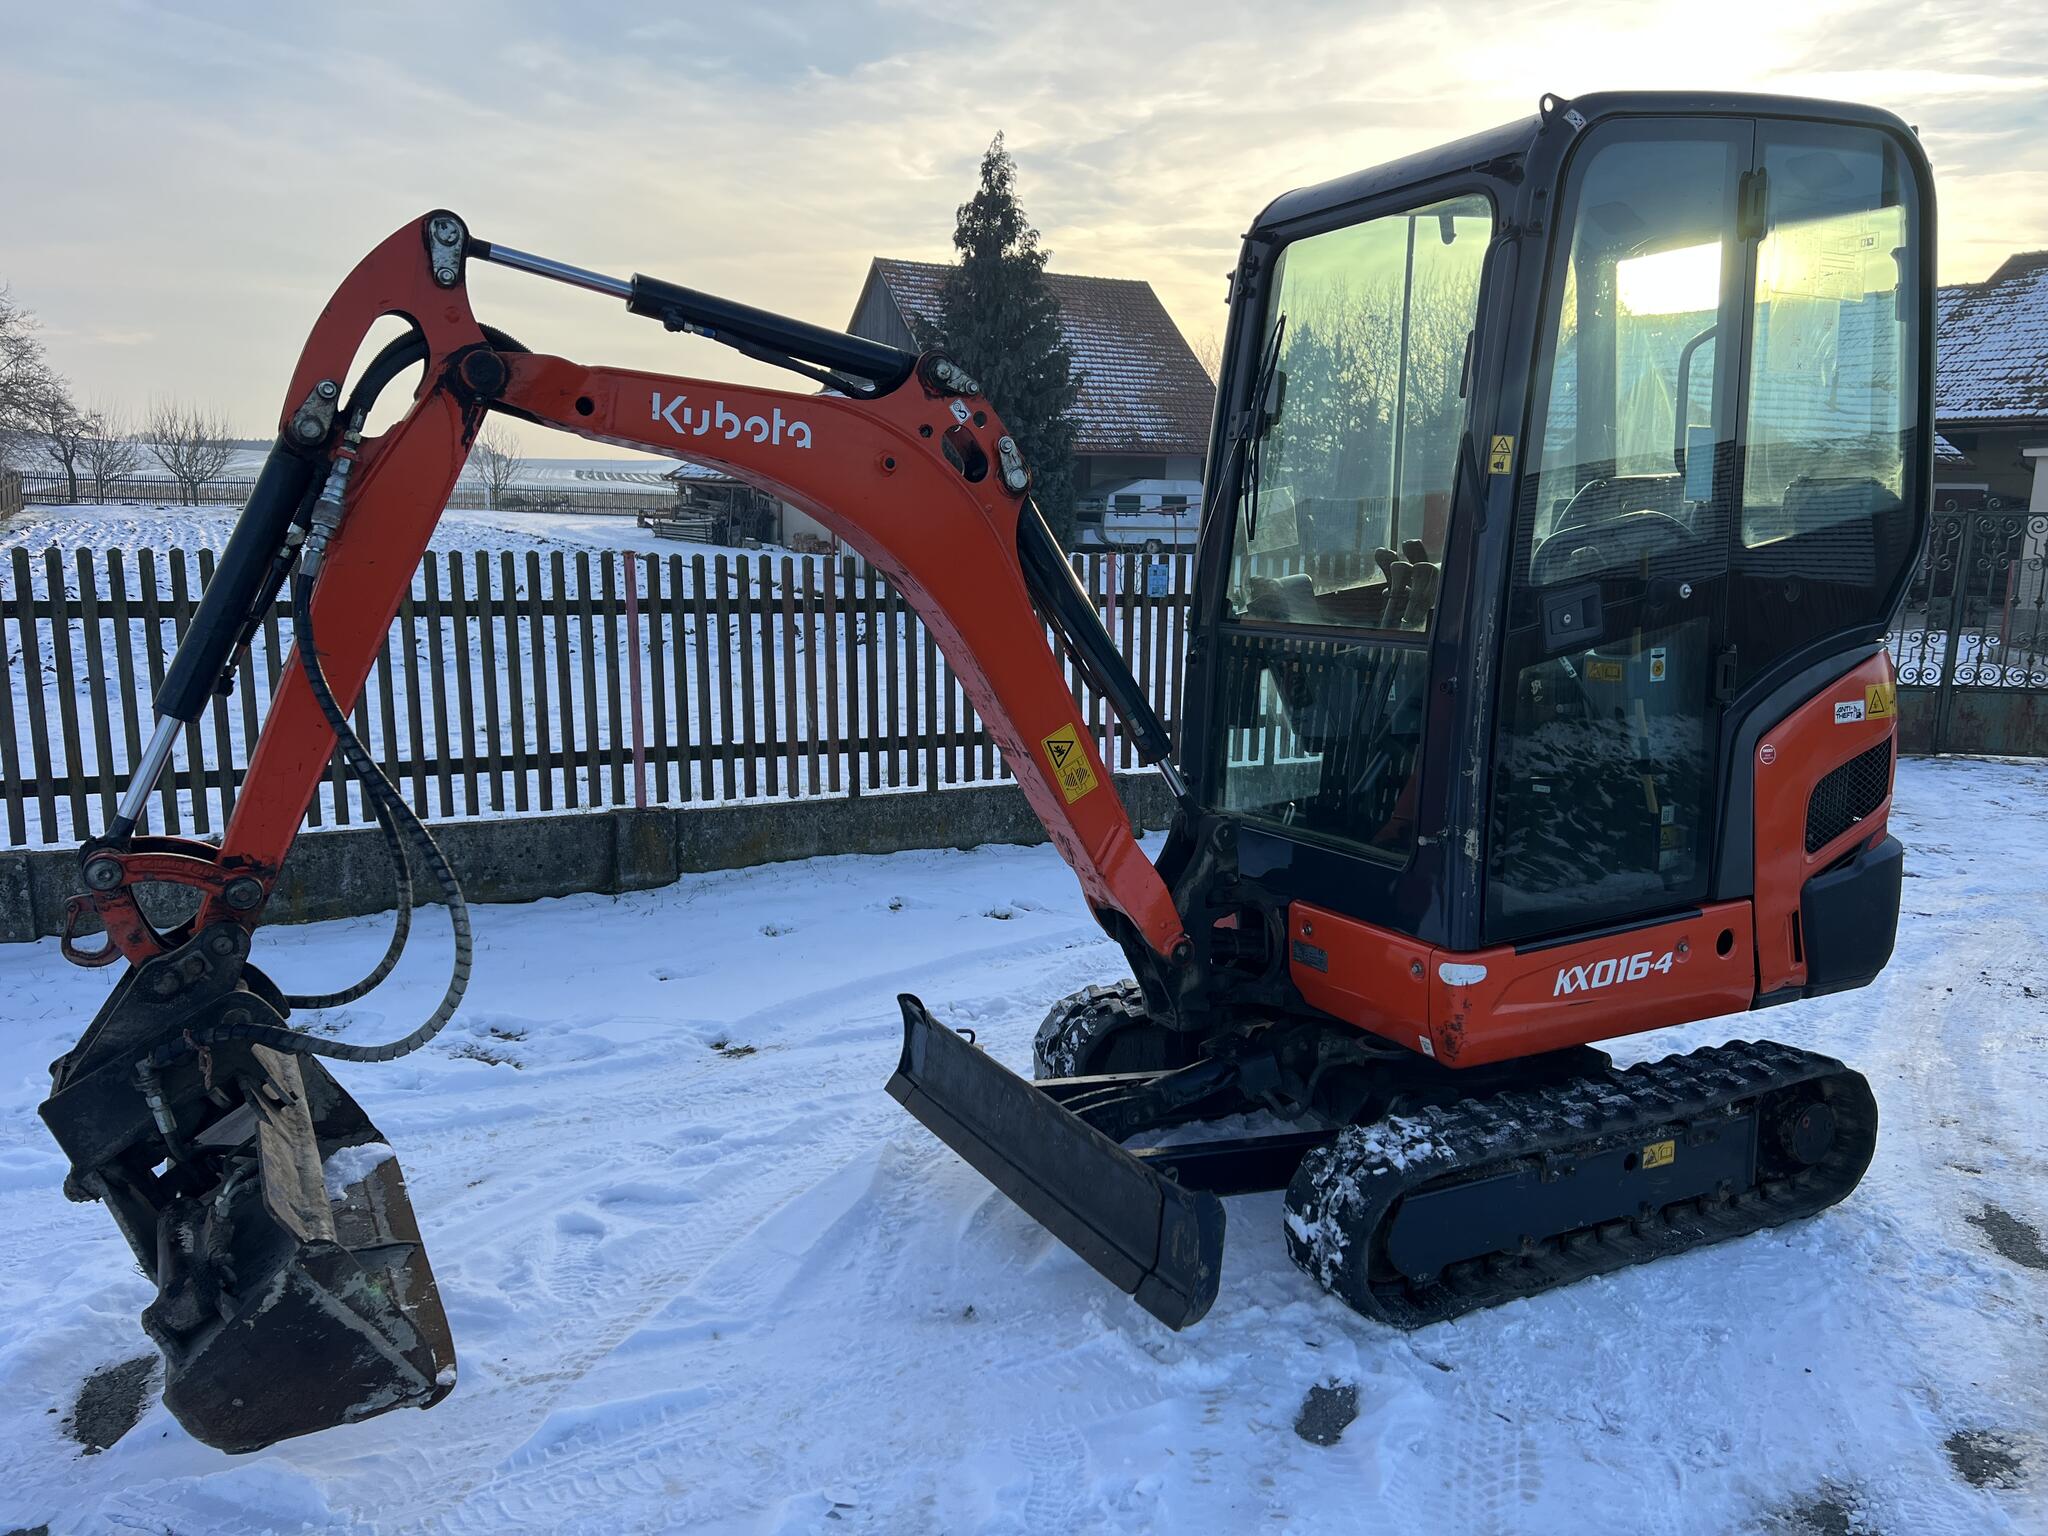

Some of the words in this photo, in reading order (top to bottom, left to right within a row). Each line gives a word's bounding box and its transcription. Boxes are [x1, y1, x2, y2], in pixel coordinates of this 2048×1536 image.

[651, 392, 812, 449] Kubota
[1835, 711, 1853, 719] THEFT
[1553, 951, 1673, 997] KX016-4
